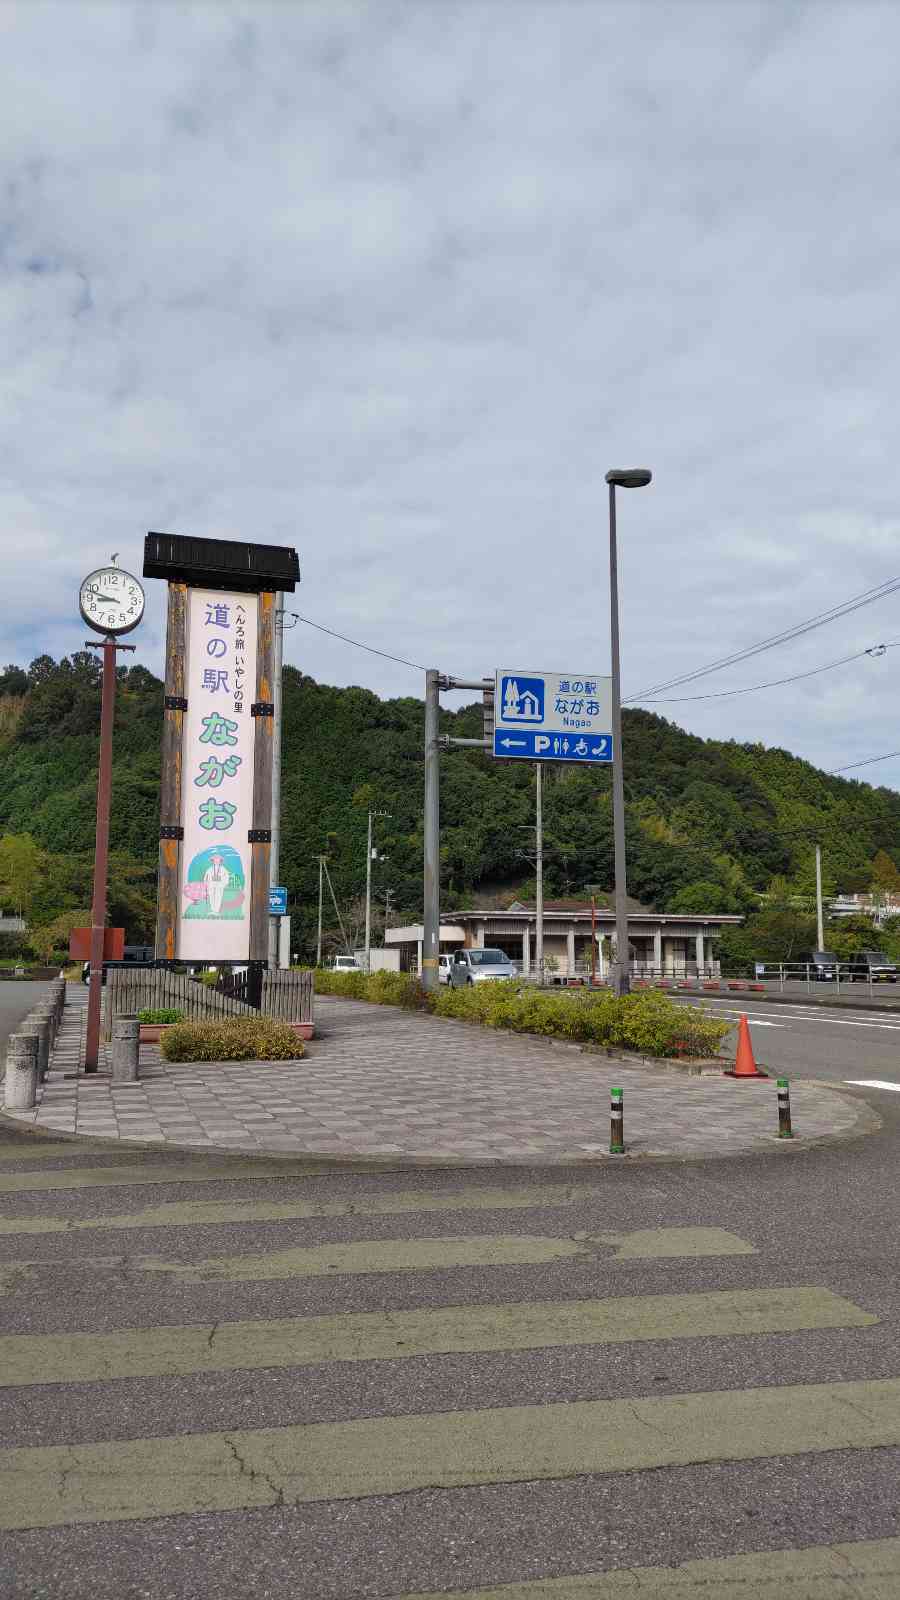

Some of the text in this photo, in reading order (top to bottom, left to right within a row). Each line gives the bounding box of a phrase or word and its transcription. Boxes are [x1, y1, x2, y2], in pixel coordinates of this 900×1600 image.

[108, 575, 118, 585] 12
[89, 583, 99, 592] 10
[128, 586, 135, 595] 2
[86, 593, 93, 602] 9
[131, 596, 138, 606] 3
[90, 602, 97, 611] 8
[126, 606, 135, 614] 4
[98, 611, 105, 620] 7
[108, 614, 115, 624] 6
[119, 613, 126, 622] 5
[202, 603, 230, 693] 道の駅
[233, 604, 246, 713] へんろ旅 いやしの里
[559, 680, 597, 694] 道の駅
[554, 698, 600, 715] ながお
[563, 717, 592, 728] Nagao
[534, 735, 551, 753] P
[194, 711, 242, 830] ながお
